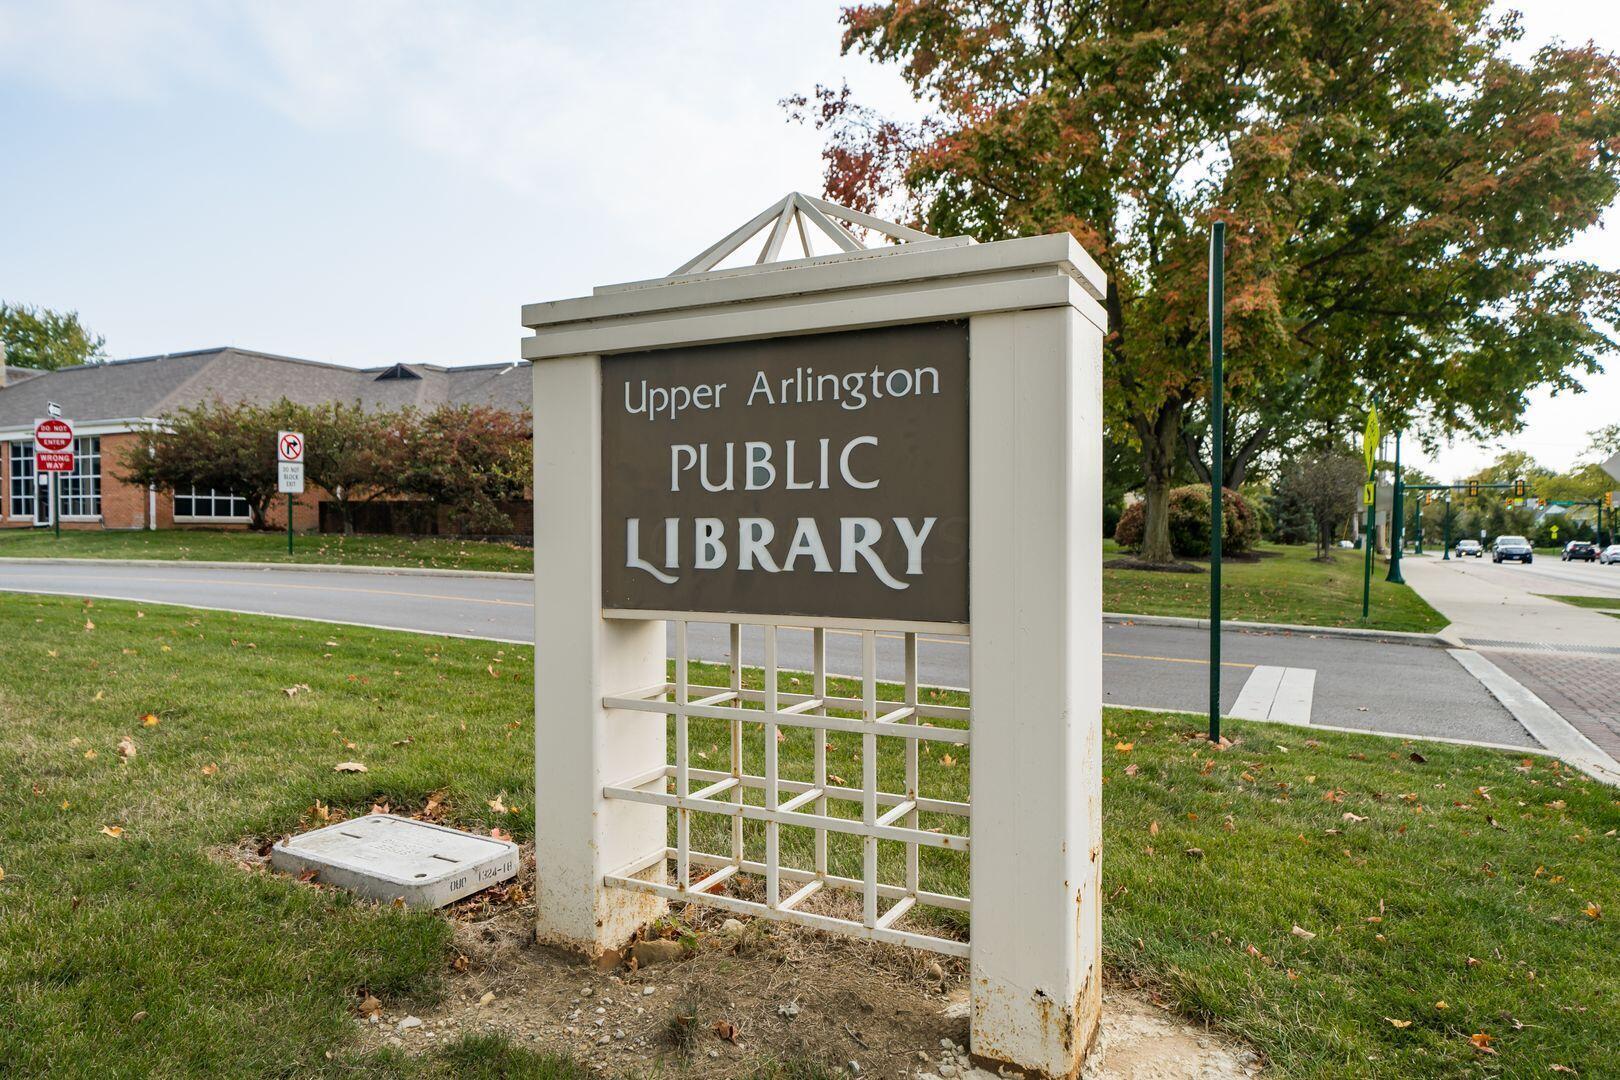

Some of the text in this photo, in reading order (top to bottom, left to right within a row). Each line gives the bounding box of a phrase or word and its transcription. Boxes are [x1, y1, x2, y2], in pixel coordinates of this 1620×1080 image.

[624, 365, 939, 421] Upper Arlington
[670, 435, 880, 492] PUBLIC
[626, 517, 938, 590] LIBRARY
